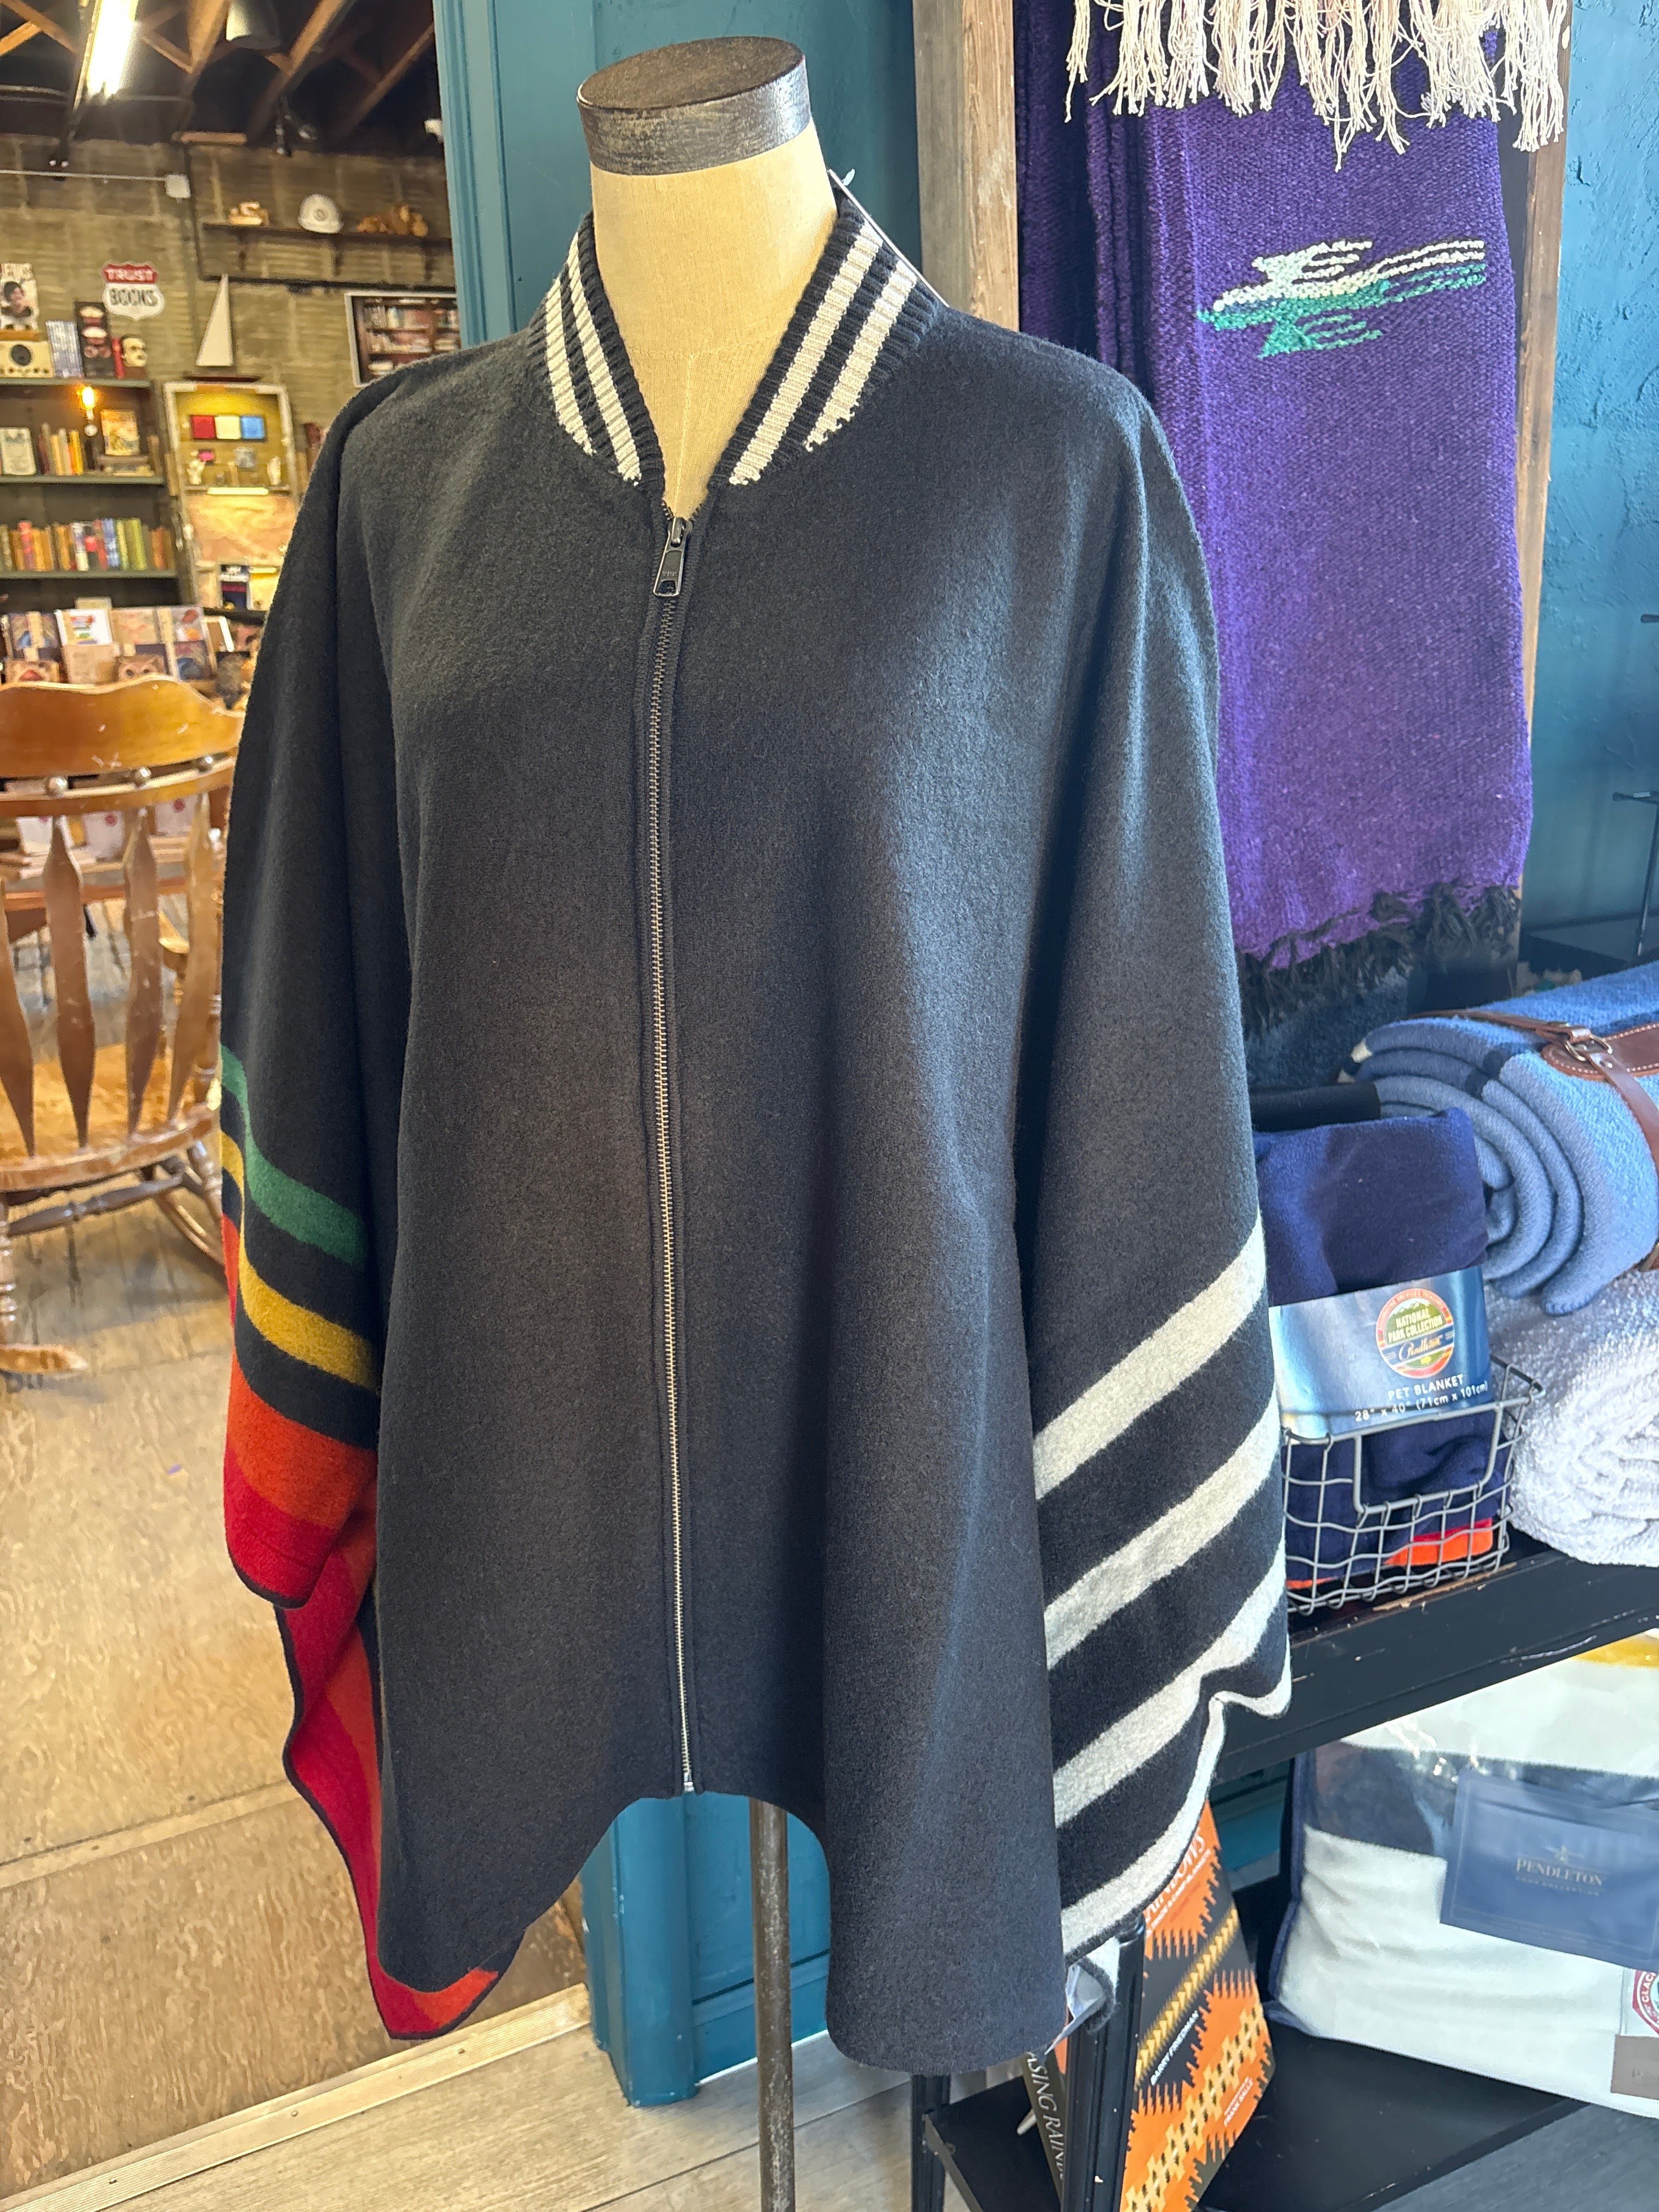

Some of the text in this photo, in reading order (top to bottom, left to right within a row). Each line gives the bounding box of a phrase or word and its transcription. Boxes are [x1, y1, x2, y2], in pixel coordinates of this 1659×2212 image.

[105, 268, 154, 281] TRUST
[110, 288, 159, 306] BOOKS
[1388, 1327, 1406, 1344] PARK
[1406, 1314, 1443, 1338] COLLECTION
[1396, 1308, 1431, 1329] NATIONAL
[1399, 1334, 1443, 1361] Pendleton
[1355, 1408, 1374, 1422] 28"
[1416, 1396, 1449, 1412] (71cm
[1452, 1392, 1458, 1401] x
[1460, 1380, 1488, 1398] 101cm)
[1387, 1374, 1464, 1401] PET BLANKET
[1516, 1857, 1602, 1886] PENDLETON
